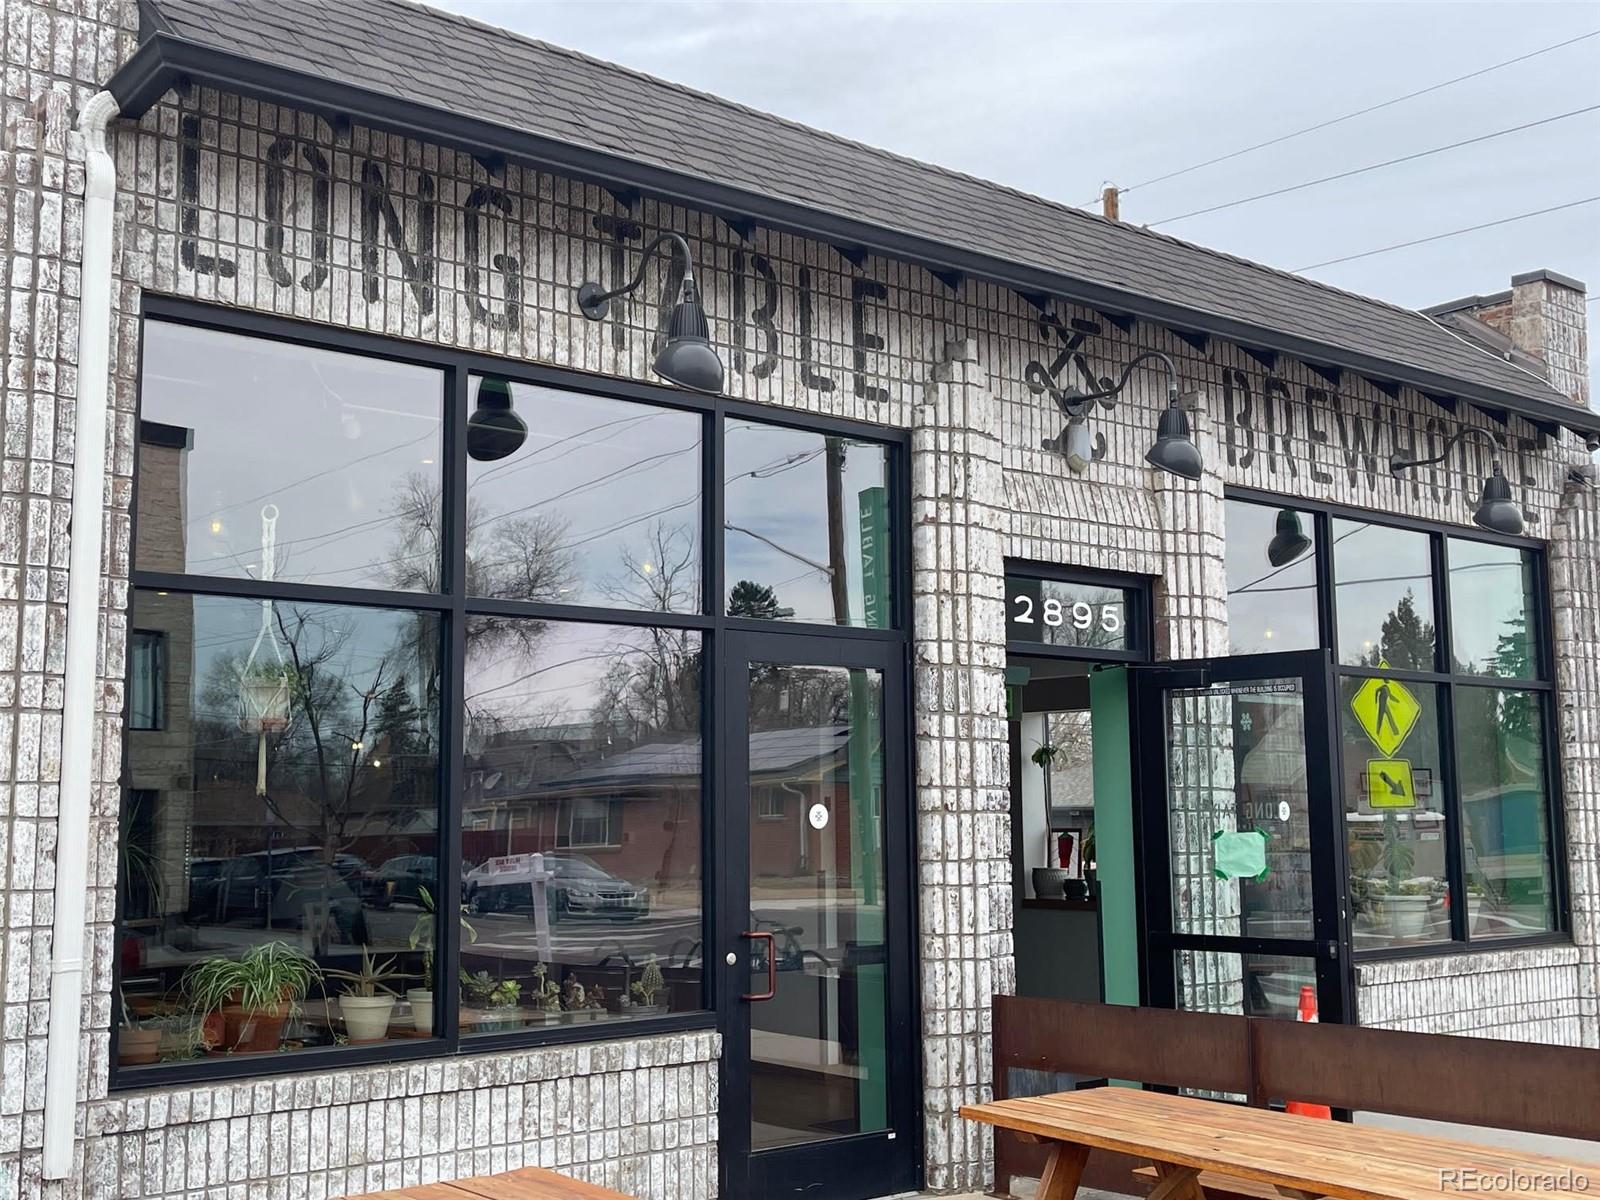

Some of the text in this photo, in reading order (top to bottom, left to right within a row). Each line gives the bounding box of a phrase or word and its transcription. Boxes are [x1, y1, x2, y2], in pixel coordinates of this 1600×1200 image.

[180, 115, 889, 402] LONG TABLE
[1222, 366, 1540, 524] BREWHOUE
[1014, 595, 1119, 632] 2895
